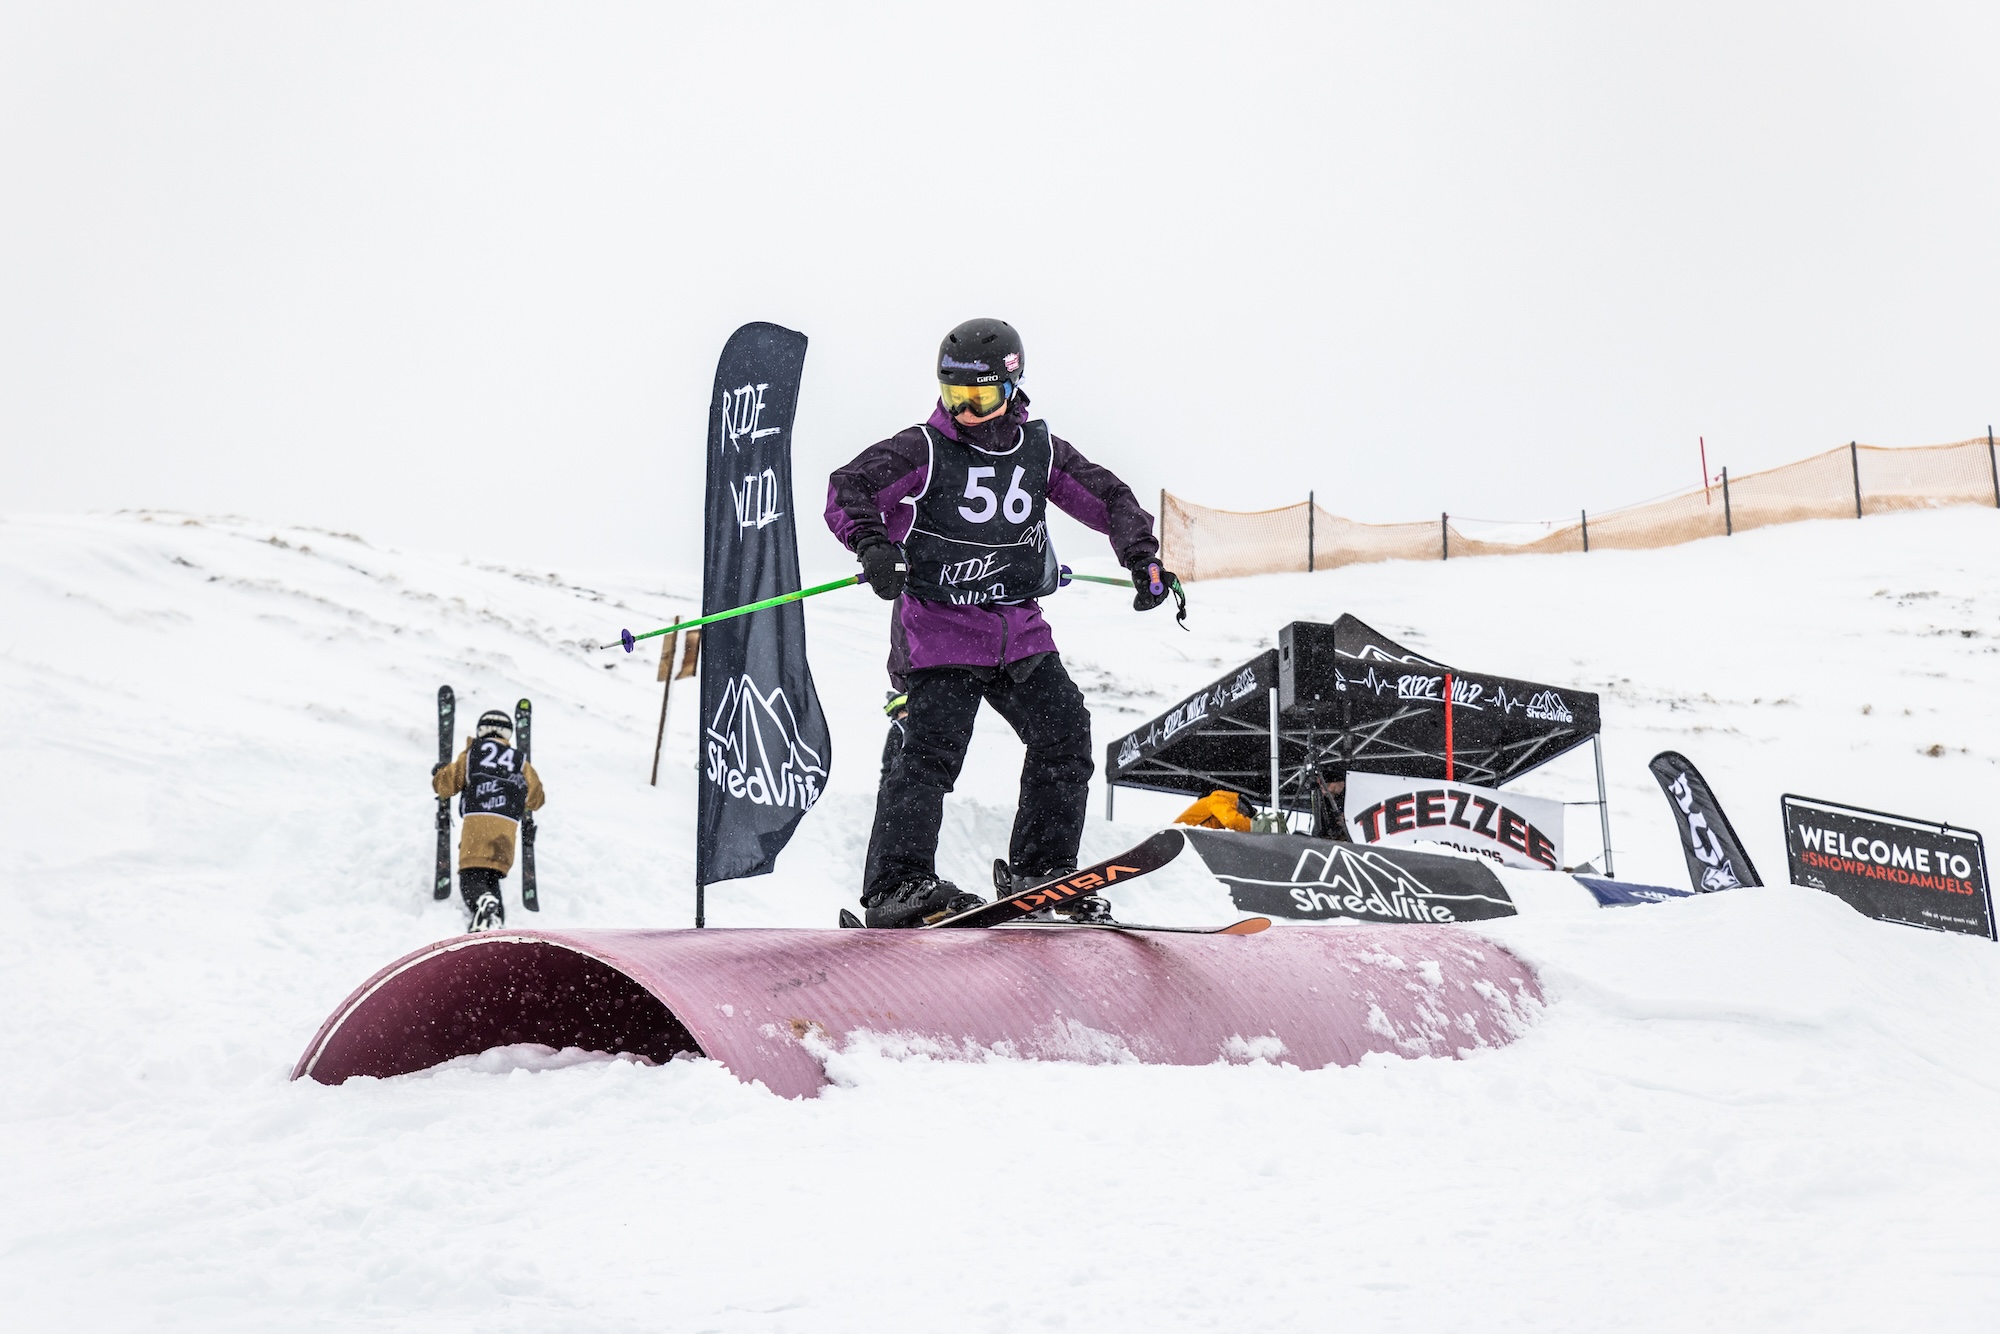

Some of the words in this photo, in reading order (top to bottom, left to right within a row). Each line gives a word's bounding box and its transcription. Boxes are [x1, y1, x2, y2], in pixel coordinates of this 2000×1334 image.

[976, 375, 999, 383] GIRO
[721, 382, 781, 455] RIDE
[730, 467, 784, 541] WILD
[958, 465, 1032, 524] 56
[939, 551, 1011, 588] RIDE
[1398, 675, 1442, 697] RIDE
[480, 742, 515, 772] 24
[476, 779, 503, 798] RIDE
[480, 795, 506, 810] WILD
[1354, 789, 1557, 871] TEEZZEE
[1799, 824, 1931, 873] WELCOME
[1935, 851, 1971, 879] TO
[1802, 852, 1974, 895] #SNOWPARKDAMUELS
